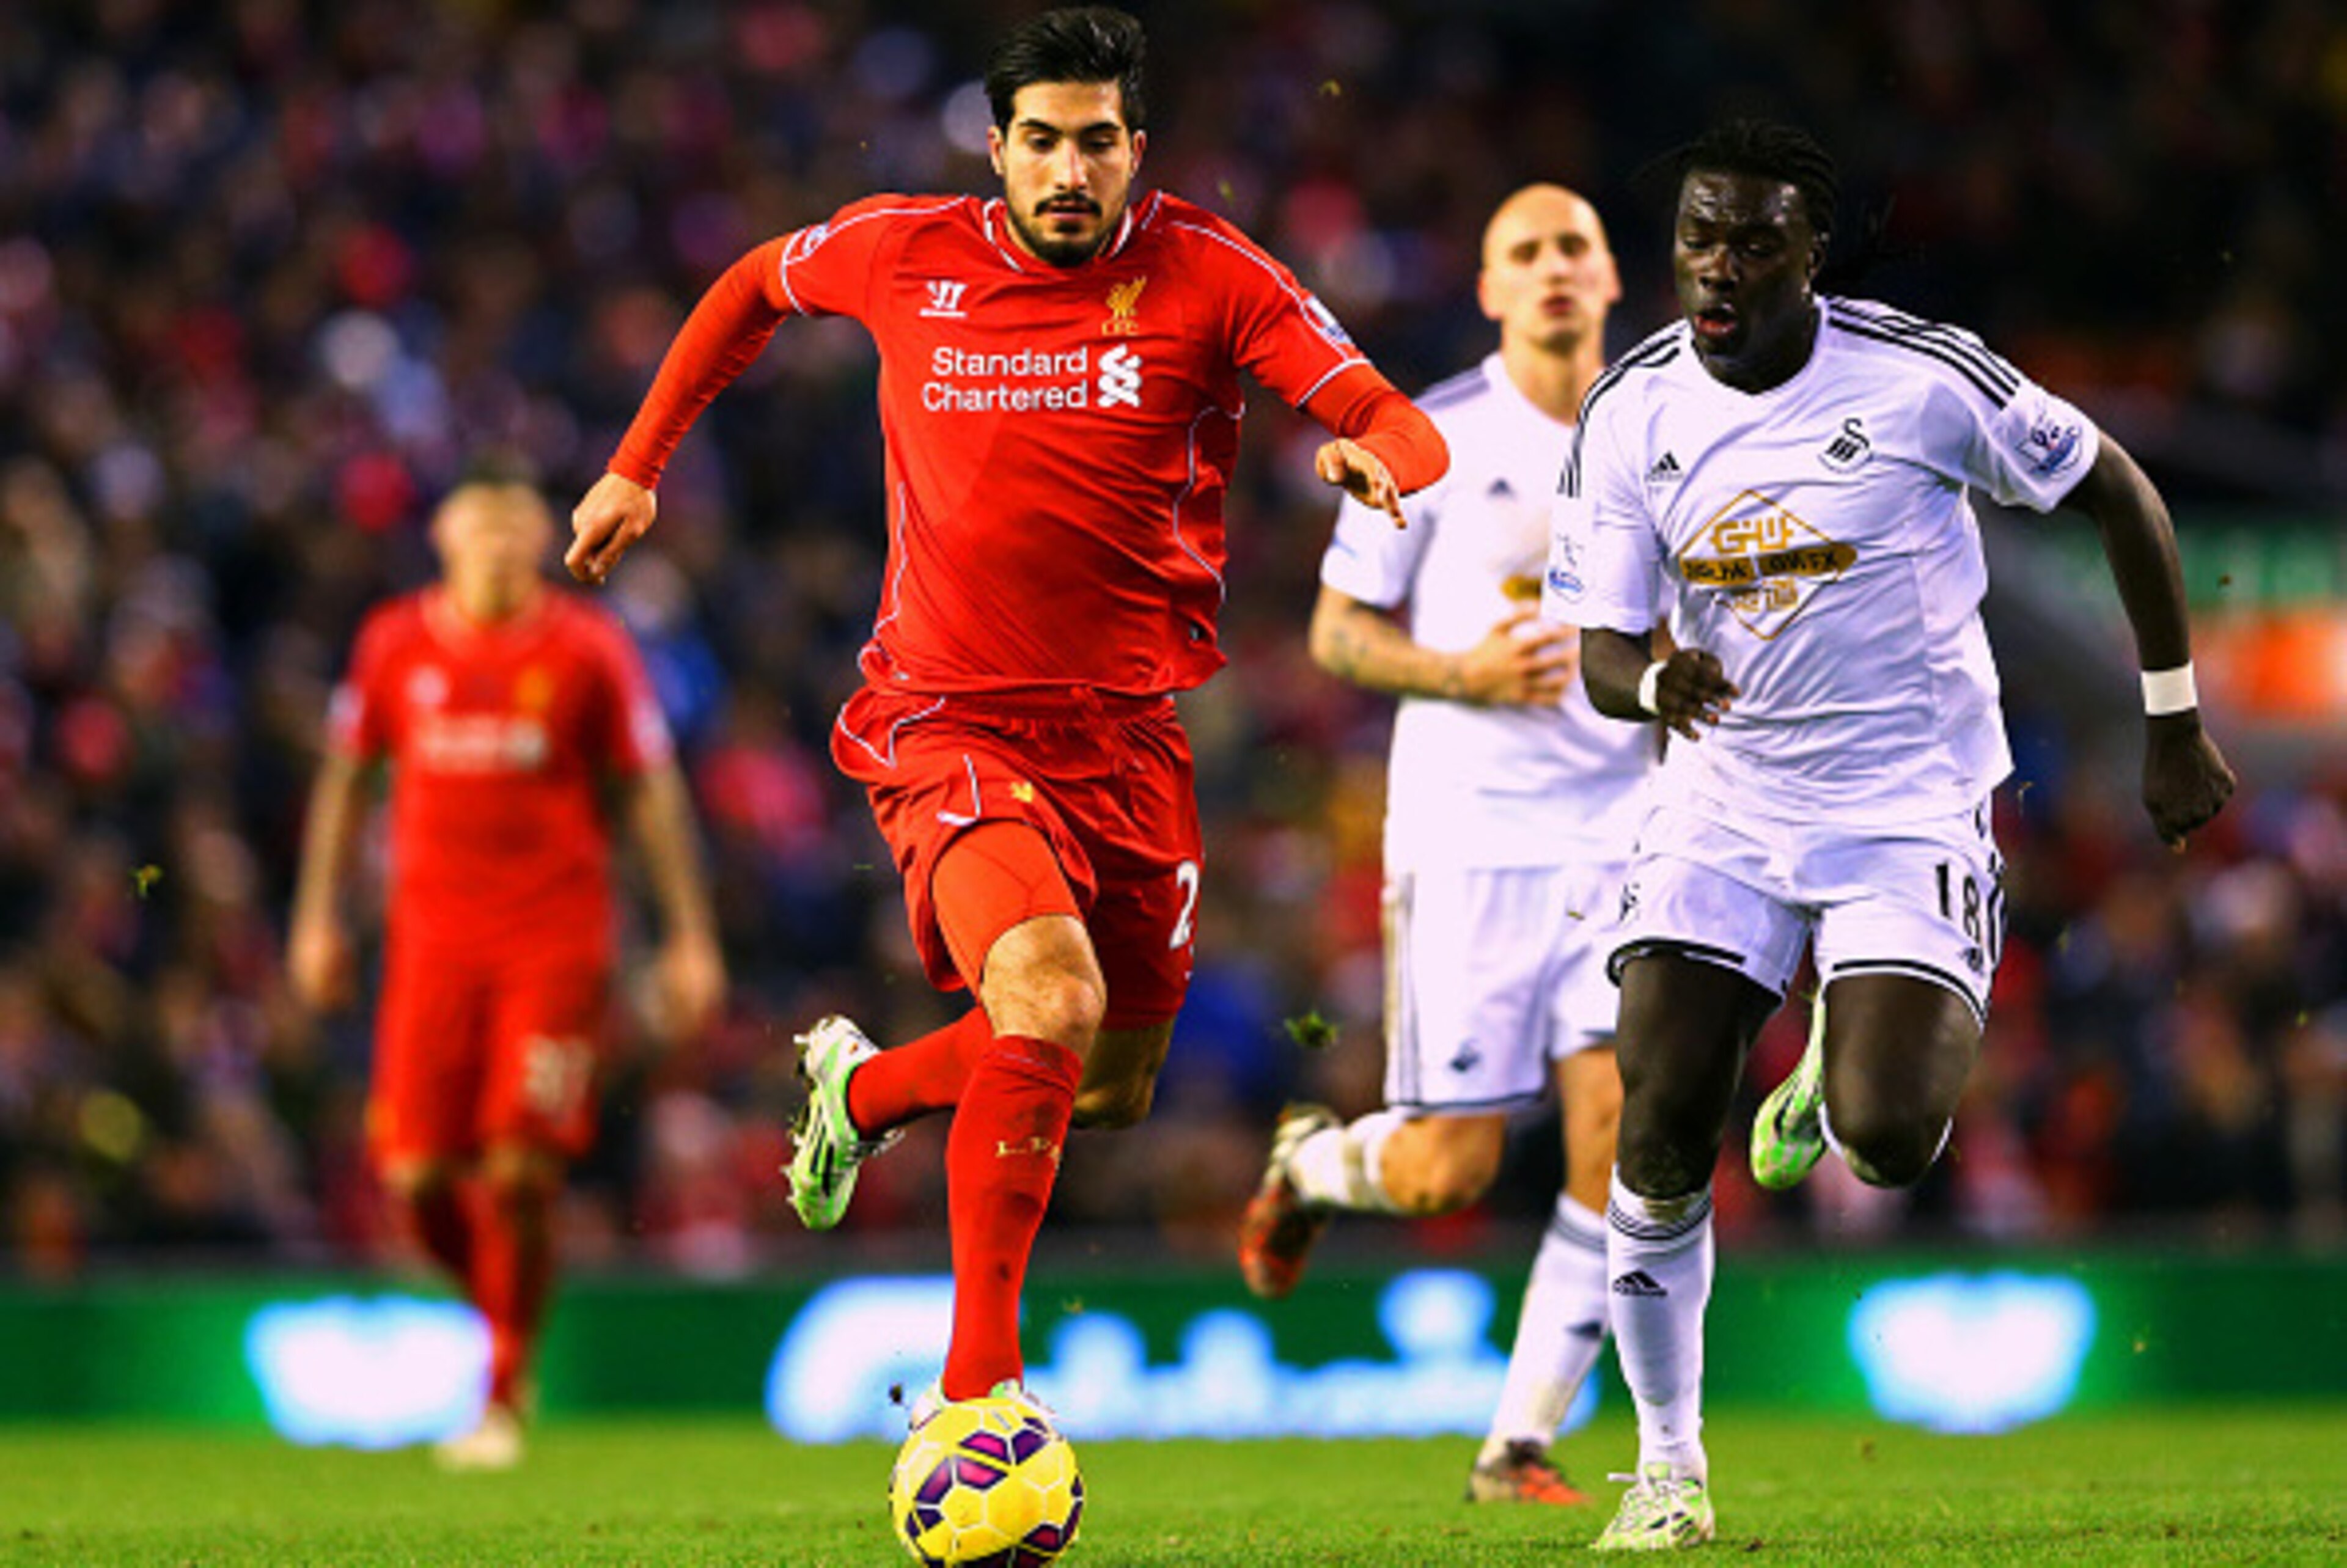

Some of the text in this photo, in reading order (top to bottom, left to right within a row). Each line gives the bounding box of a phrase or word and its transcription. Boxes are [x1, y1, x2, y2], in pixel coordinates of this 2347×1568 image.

[932, 346, 1087, 376] Standard
[921, 379, 1088, 411] Chartered
[1935, 861, 1982, 943] 18
